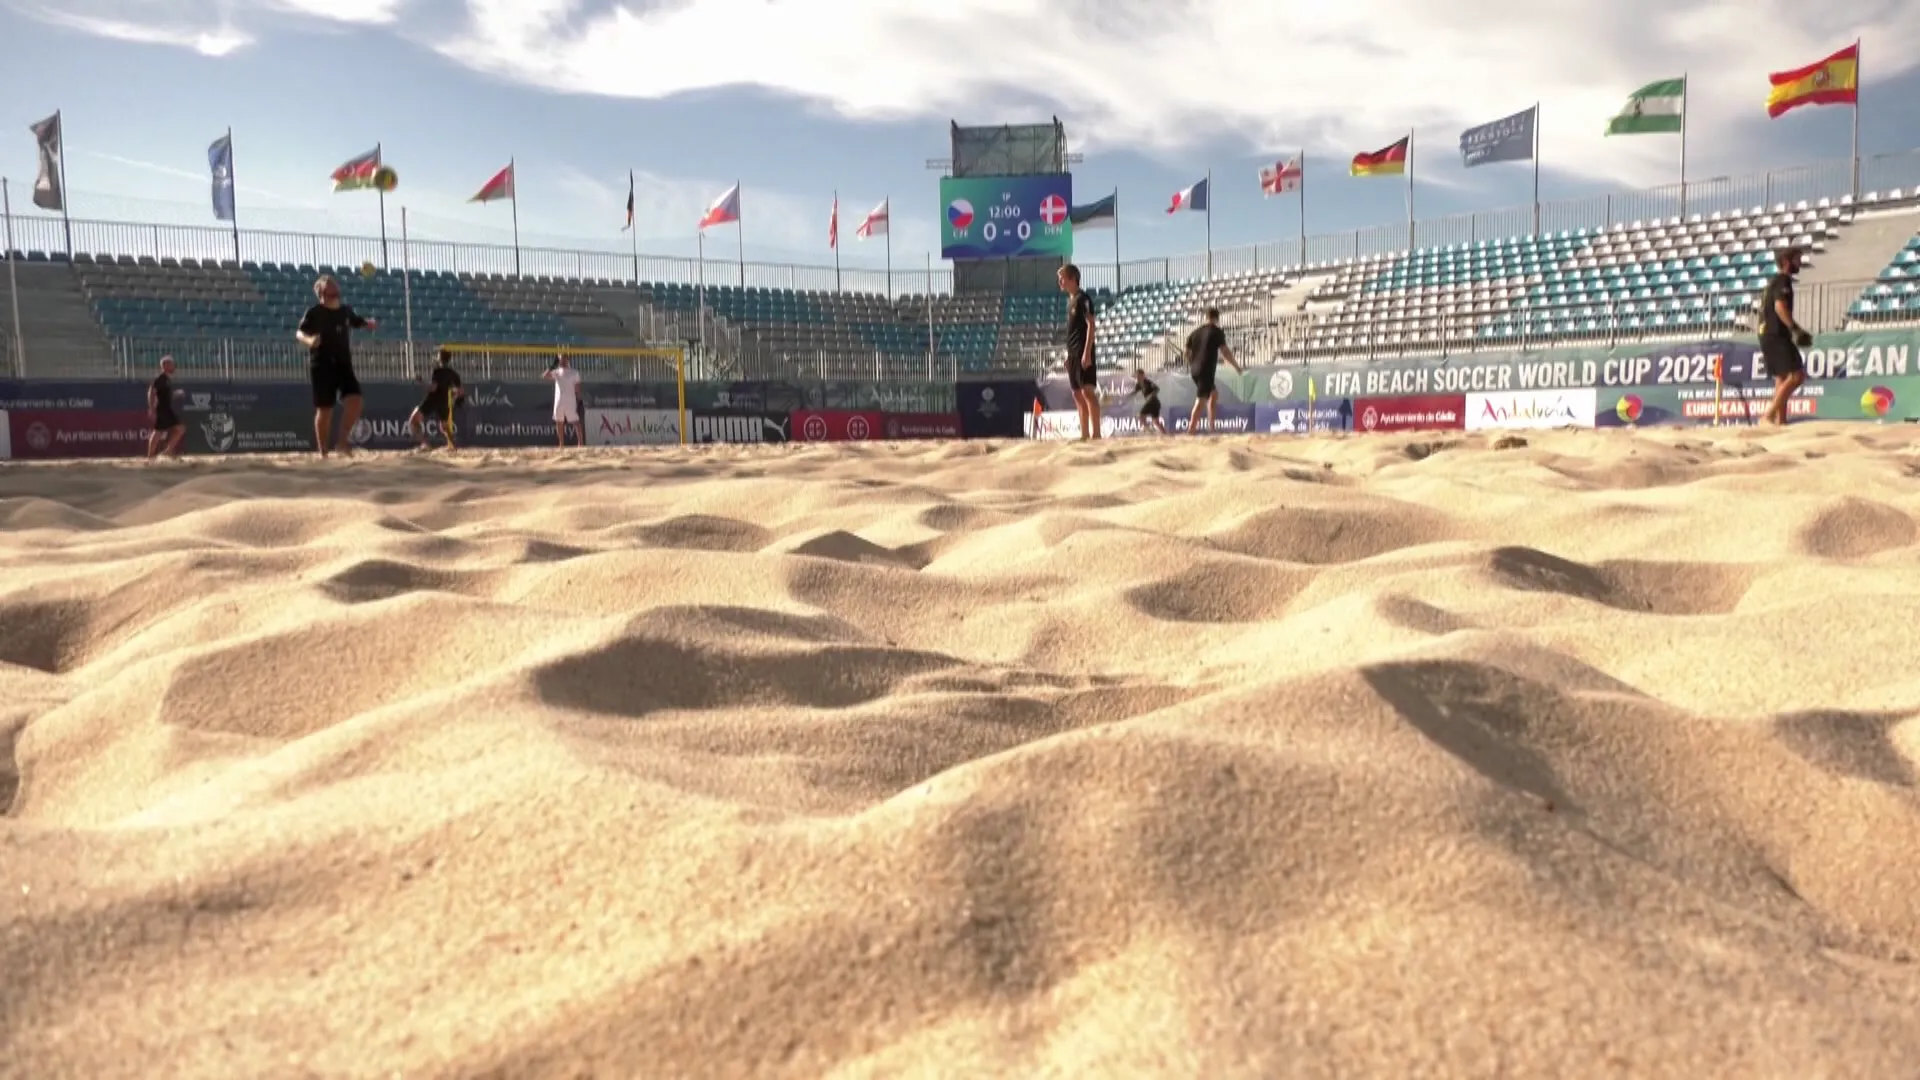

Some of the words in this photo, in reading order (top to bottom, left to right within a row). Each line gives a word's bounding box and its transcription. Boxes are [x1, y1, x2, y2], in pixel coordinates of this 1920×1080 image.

[988, 205, 1020, 219] 12:00
[983, 221, 997, 241] 0
[1017, 220, 1031, 240] 0
[1325, 372, 1360, 396] FIFA
[1366, 368, 1428, 395] BEACH
[1433, 364, 1511, 392] SOCCER
[1518, 359, 1597, 389] WORLD
[1603, 356, 1651, 385] CUP
[1657, 353, 1721, 384] 2025
[1751, 344, 1908, 381] EOPEAN
[1482, 396, 1576, 422] Andalucía
[695, 415, 763, 442] PUMA
